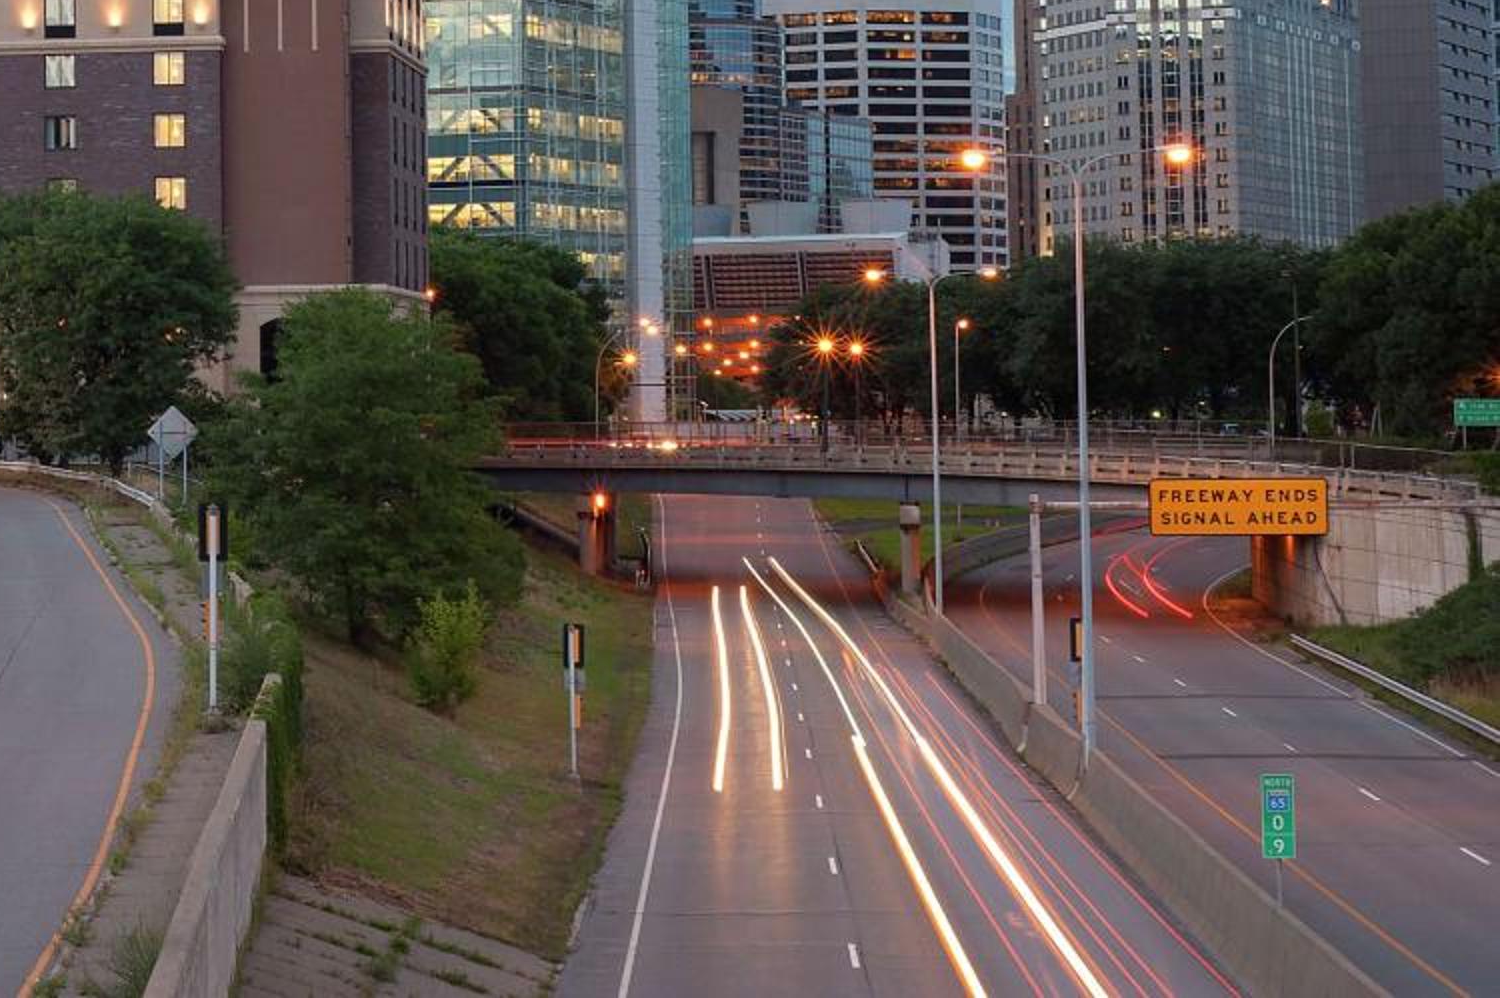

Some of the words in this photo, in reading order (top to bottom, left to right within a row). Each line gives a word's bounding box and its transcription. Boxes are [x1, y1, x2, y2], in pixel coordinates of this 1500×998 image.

[1159, 489, 1254, 503] FREEWAY
[1265, 489, 1318, 502] ENDS
[1161, 511, 1235, 525] SIGNAL
[1247, 511, 1318, 525] AHEAD
[1271, 798, 1285, 810] 65
[1272, 815, 1284, 831] 0
